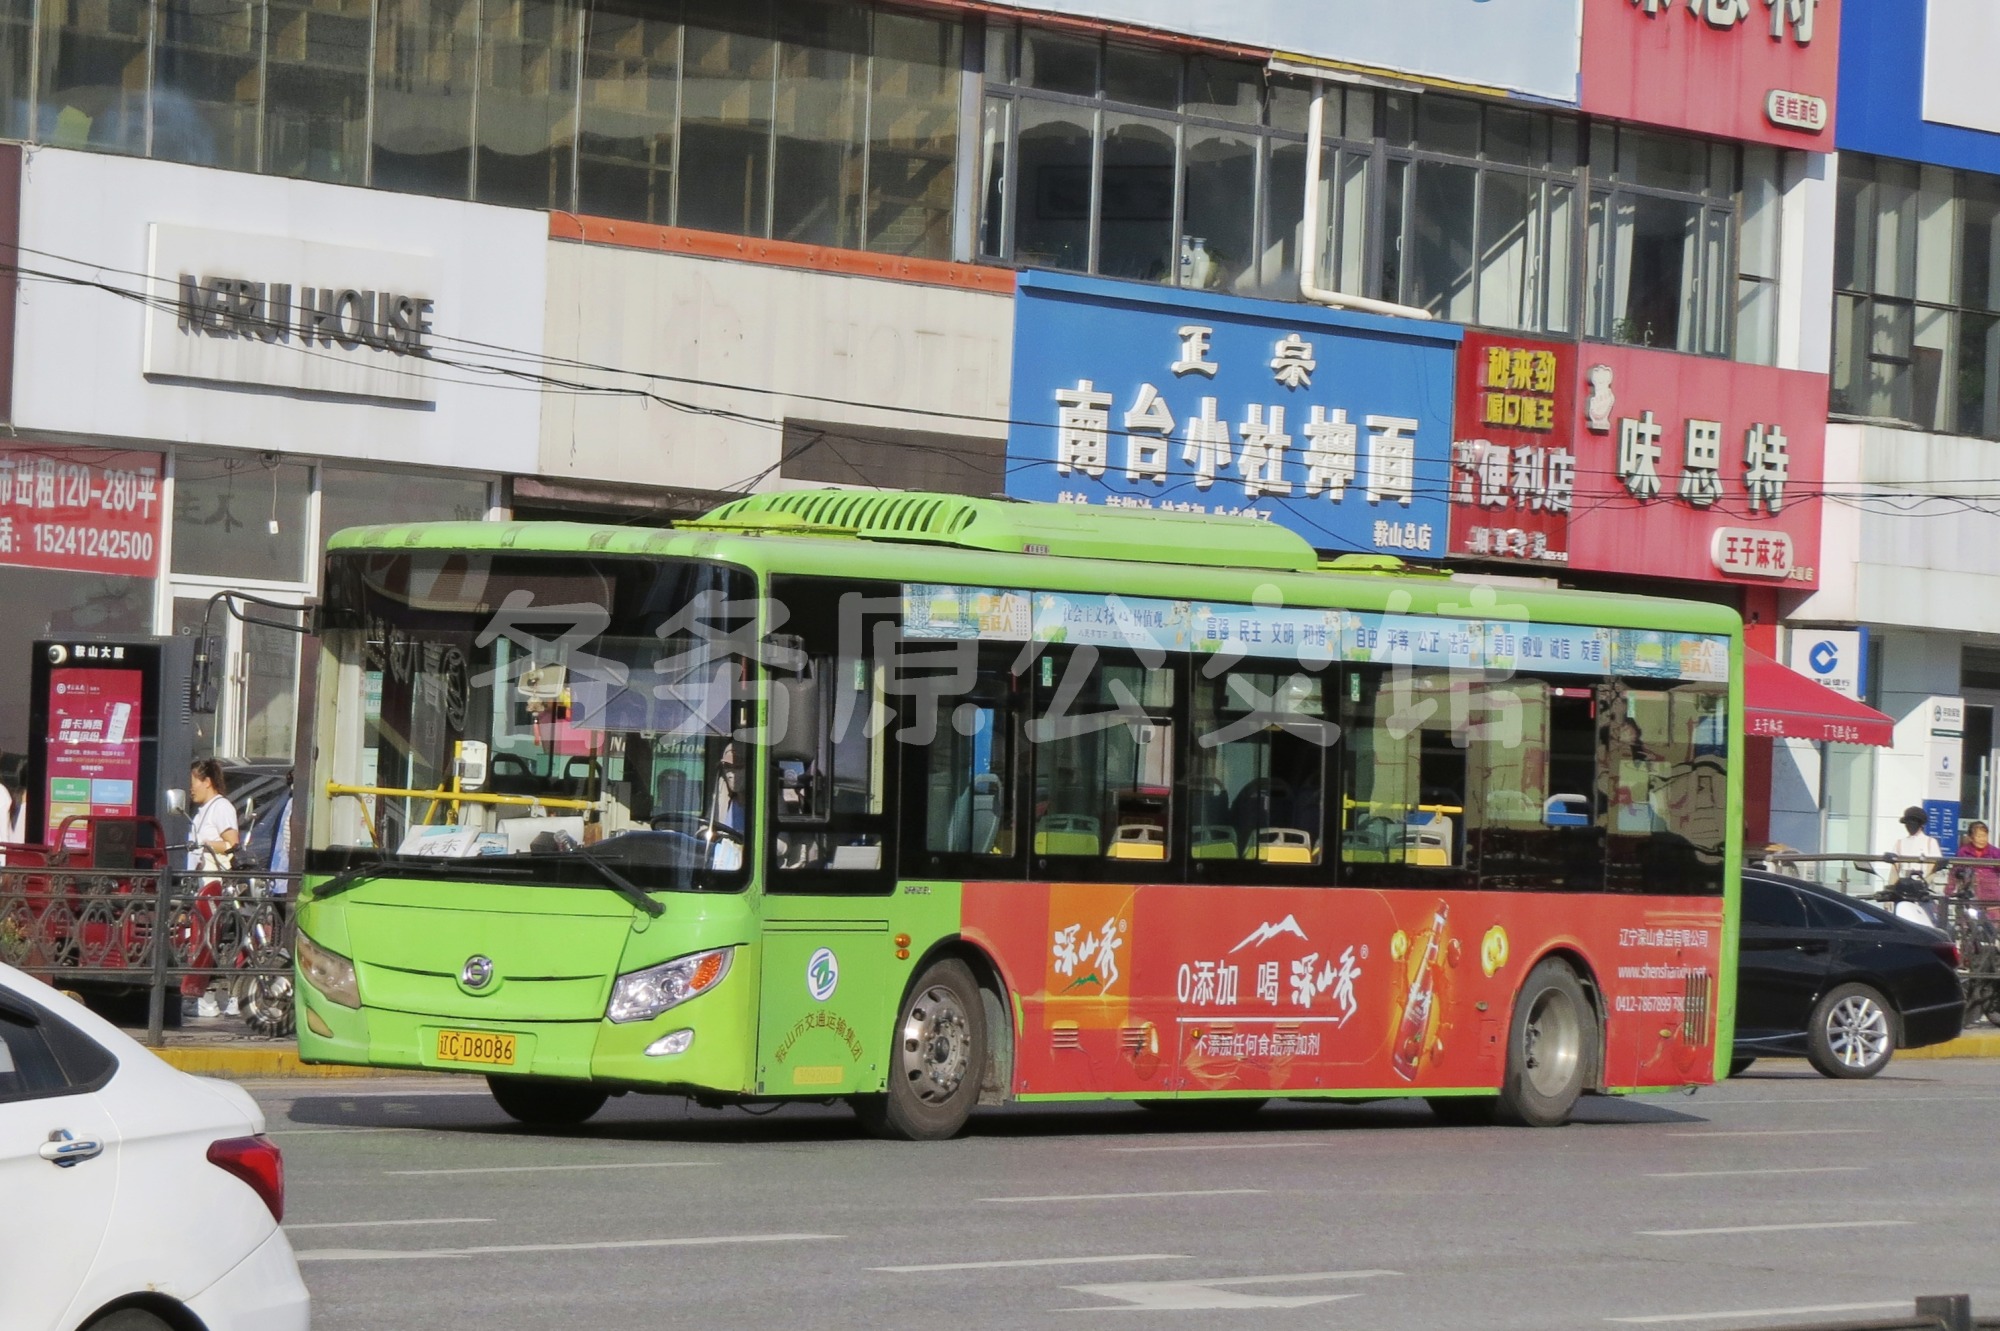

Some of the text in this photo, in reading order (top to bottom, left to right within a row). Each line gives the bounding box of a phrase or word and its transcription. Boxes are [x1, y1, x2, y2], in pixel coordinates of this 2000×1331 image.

[1775, 95, 1818, 123] 蛋糕面包
[300, 287, 434, 357] HOUSE
[1171, 325, 1316, 390] 正宗
[1479, 444, 1576, 513] 便利店
[1616, 410, 1789, 517] 味思特
[1725, 536, 1786, 570] 王子麻花
[1206, 616, 1229, 641] 富强
[1239, 619, 1262, 644] 民主
[1271, 621, 1294, 645] 文明
[1356, 625, 1378, 649] 自由
[1387, 628, 1409, 651] 平等
[1418, 630, 1439, 654] 公正
[1522, 635, 1542, 659] 敬业
[1550, 637, 1570, 660] 诚信
[1619, 928, 1708, 947] 辽宁深山食品有限公司
[1177, 960, 1239, 1006] 0添加
[1257, 961, 1279, 1006] 喝
[775, 1009, 863, 1064] 鞍山市交通运输集团
[1194, 1032, 1320, 1056] 不添加任何食品添加剂
